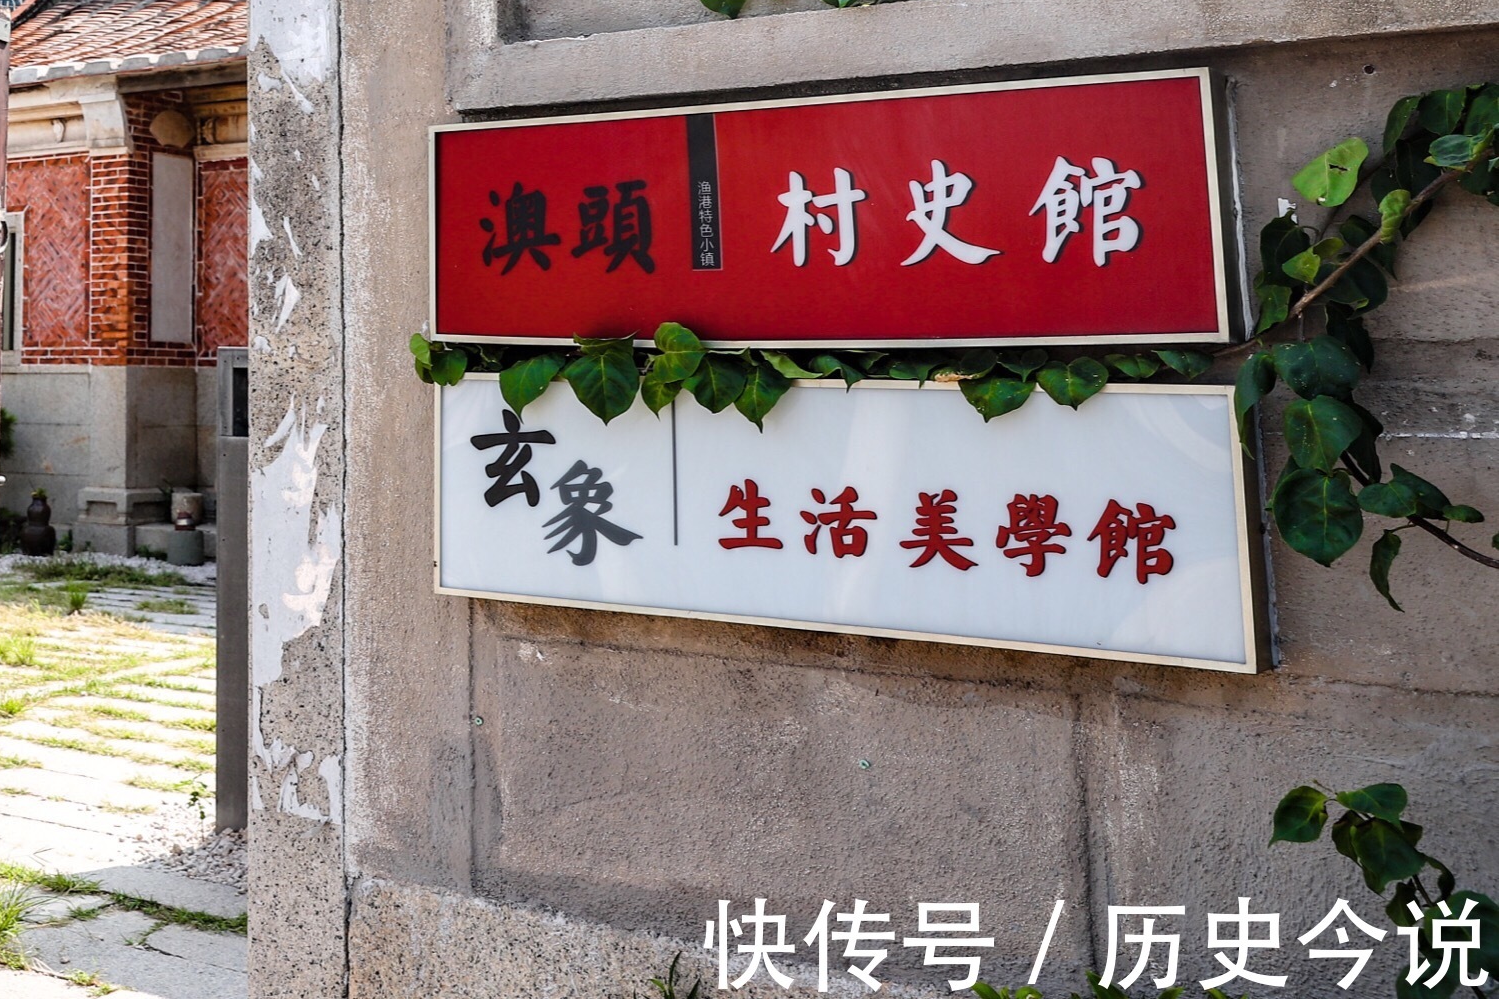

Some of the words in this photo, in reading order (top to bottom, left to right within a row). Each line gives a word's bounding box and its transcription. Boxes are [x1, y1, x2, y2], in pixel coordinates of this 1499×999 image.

[479, 179, 655, 275] 澳頭
[771, 156, 1144, 267] 村史館
[698, 181, 714, 266] 渔港特色小镇
[469, 410, 642, 567] 玄象
[718, 479, 1177, 585] 生活美學館
